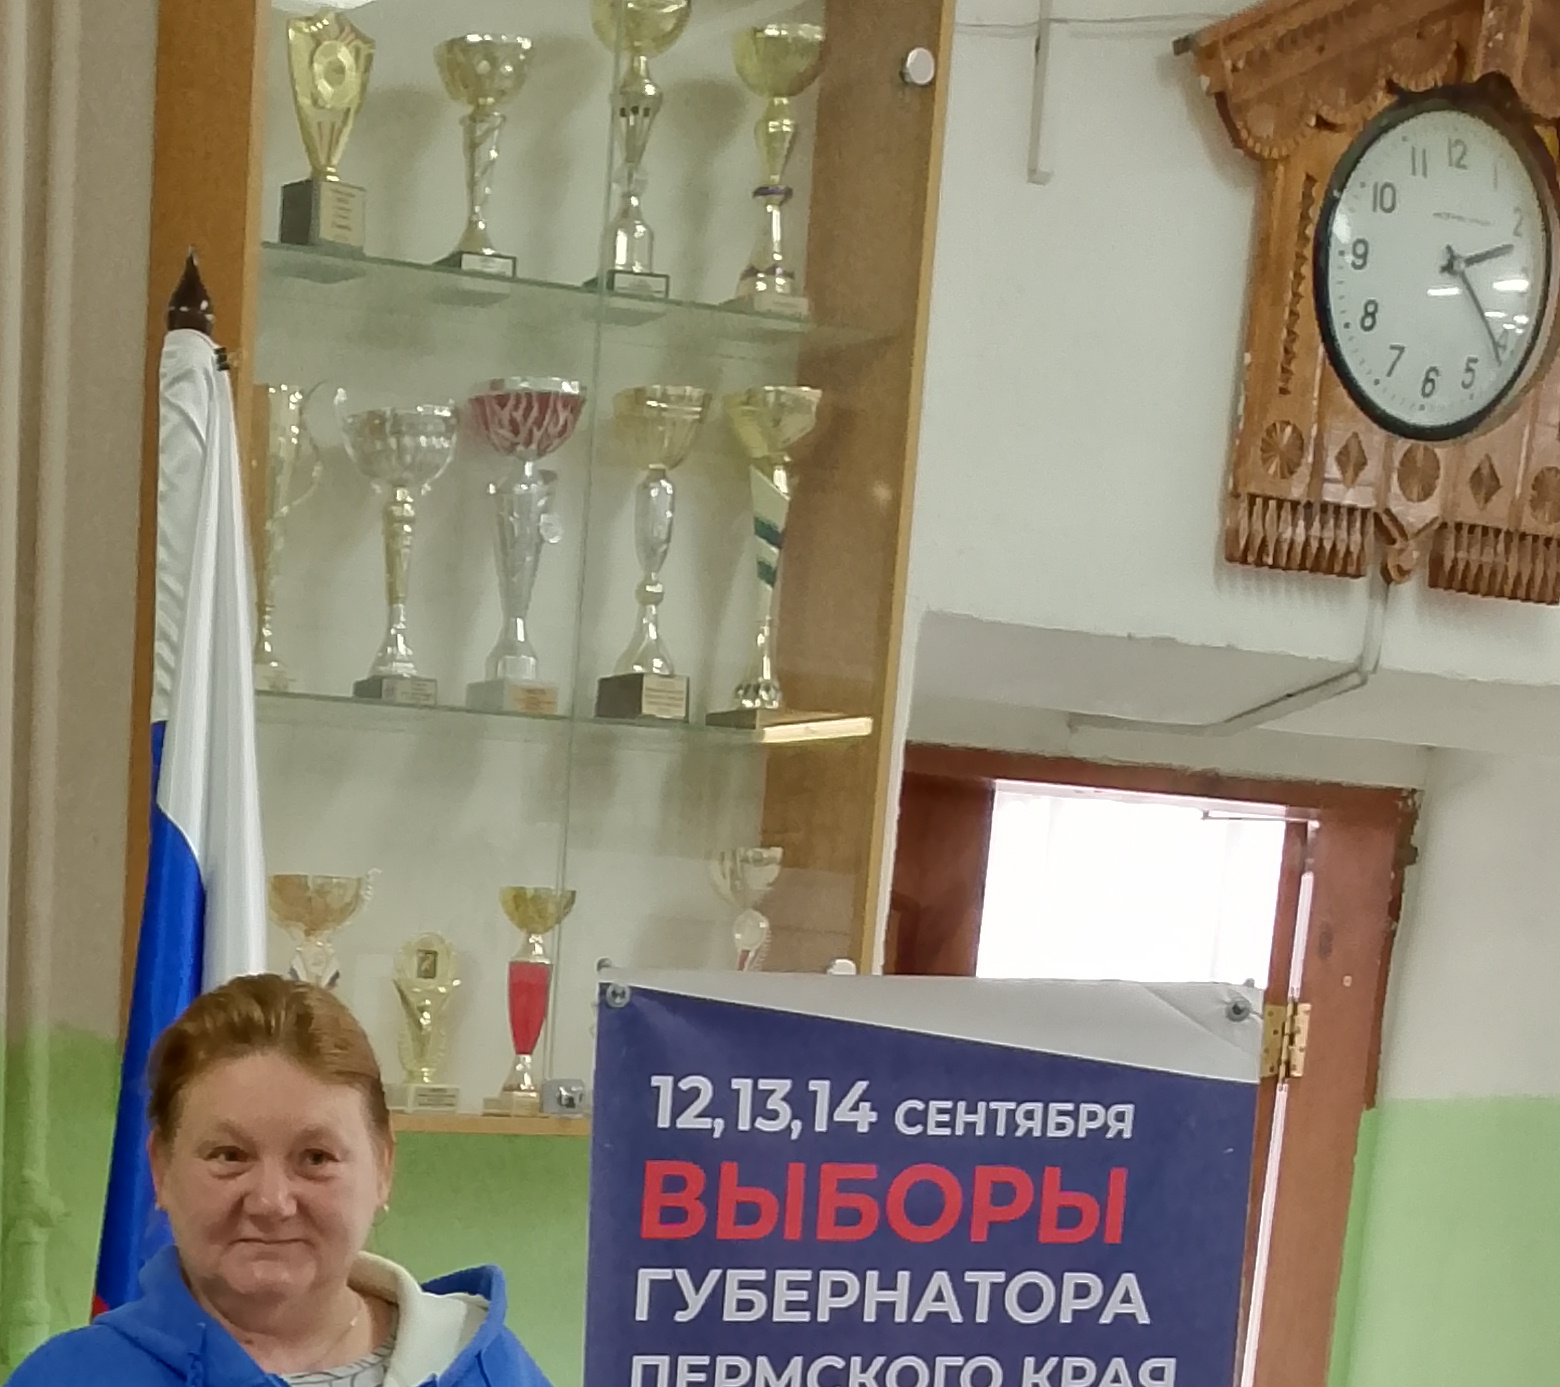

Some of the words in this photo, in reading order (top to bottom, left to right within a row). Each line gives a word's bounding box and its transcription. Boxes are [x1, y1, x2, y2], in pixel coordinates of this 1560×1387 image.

[1411, 145, 1428, 178] 11
[1447, 138, 1469, 170] 12
[1372, 181, 1396, 213] 10
[1513, 206, 1523, 237] 2
[1350, 238, 1369, 270] 9
[1360, 299, 1378, 332] 8
[1386, 344, 1406, 377] 7
[1461, 357, 1479, 390] 5
[1421, 367, 1440, 399] 6
[894, 1100, 1135, 1138] СЕНТЯБРЯ
[641, 1159, 1128, 1244] ВЫБОРЫ
[635, 1268, 1150, 1325] ГУБЕРНАТОРА
